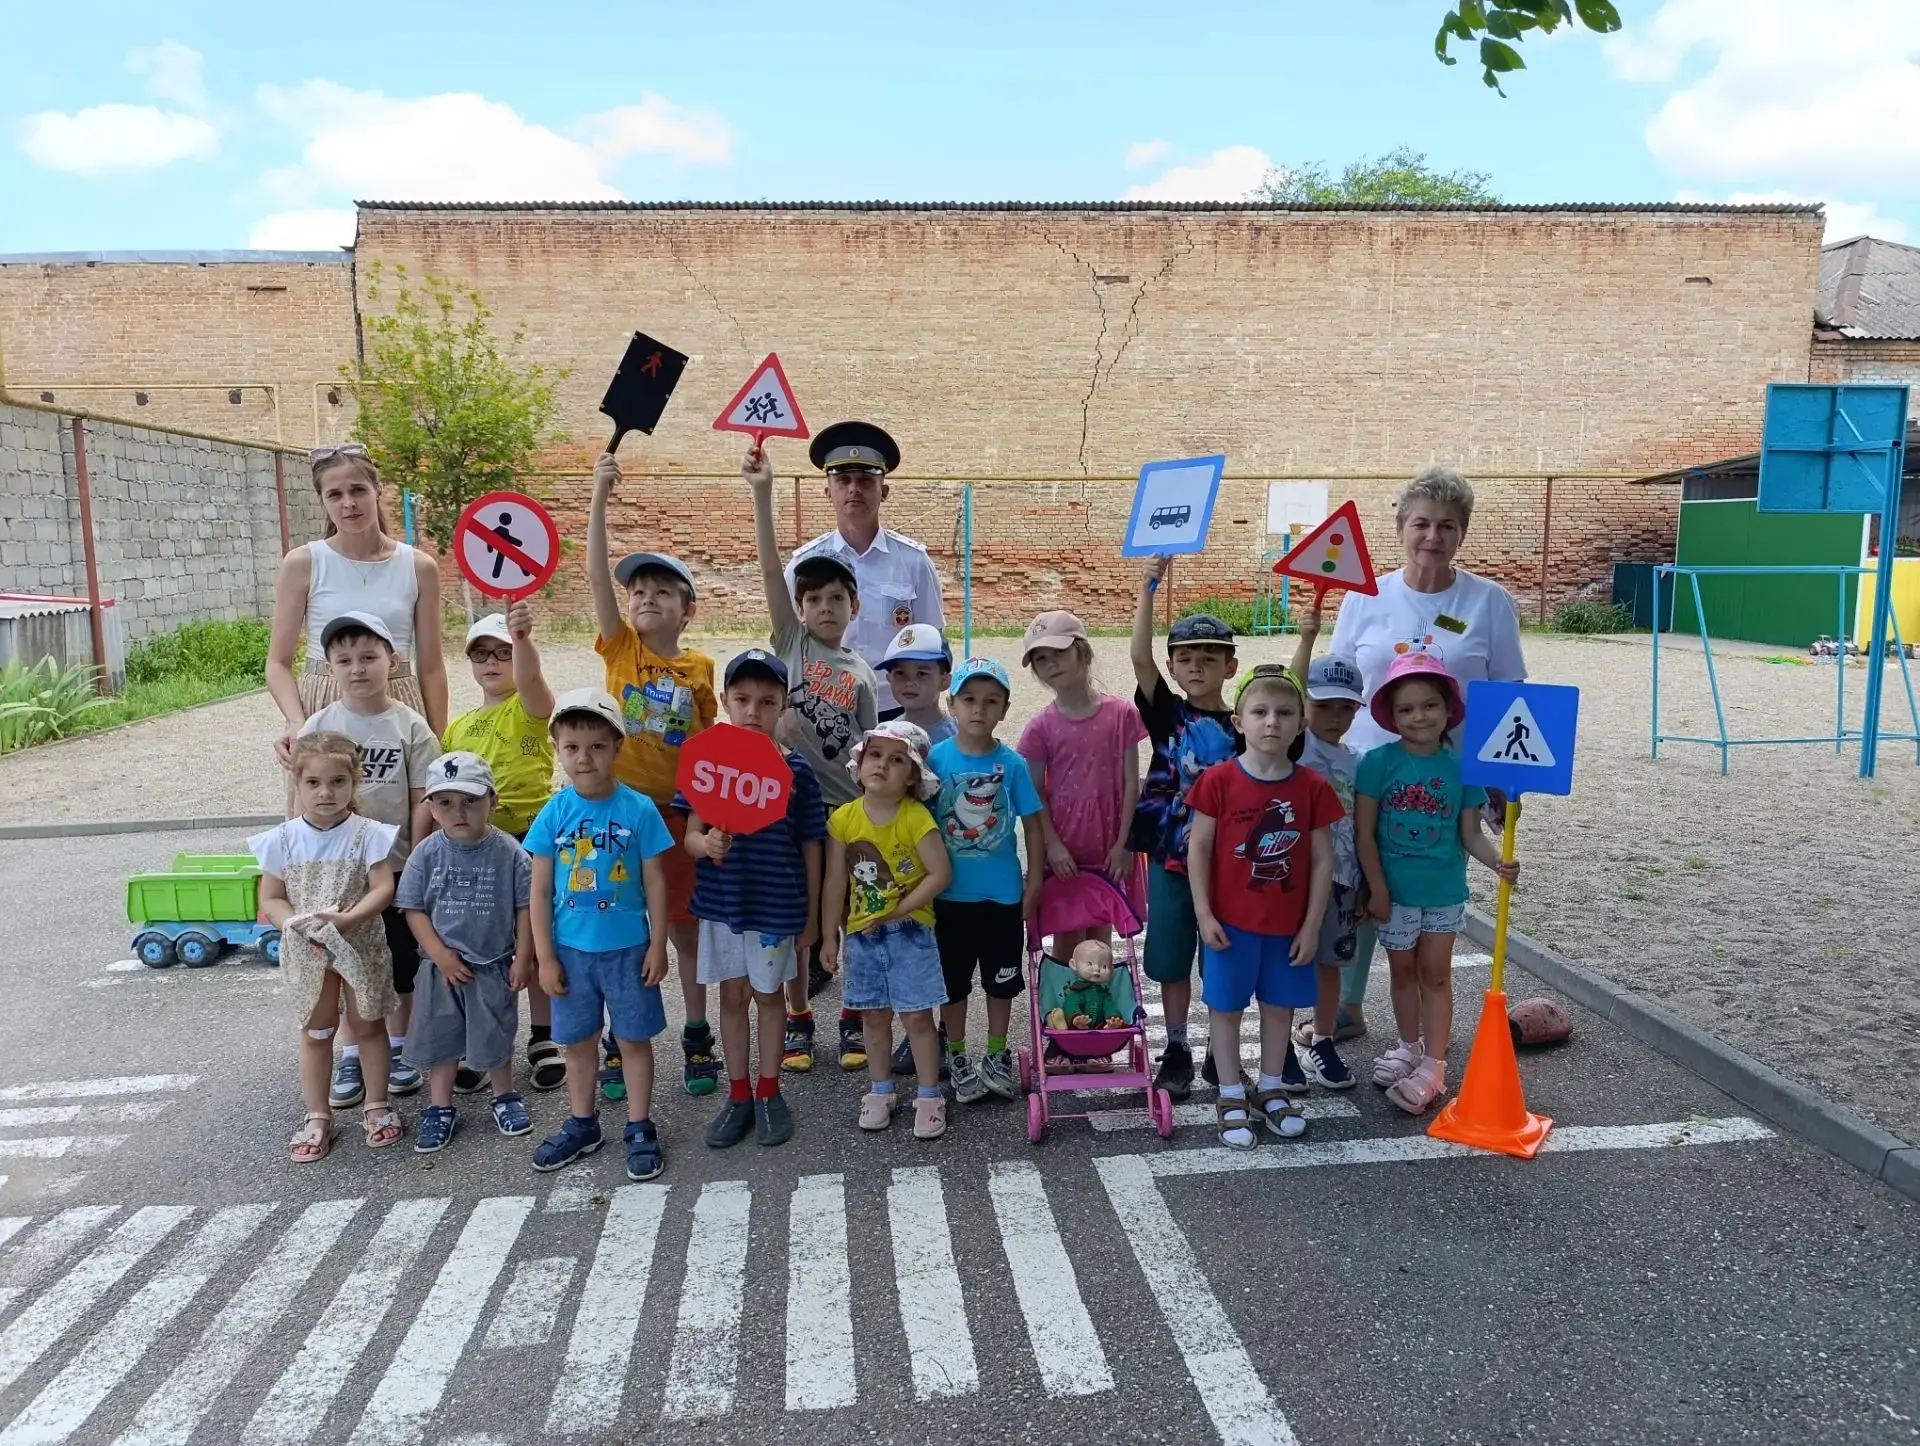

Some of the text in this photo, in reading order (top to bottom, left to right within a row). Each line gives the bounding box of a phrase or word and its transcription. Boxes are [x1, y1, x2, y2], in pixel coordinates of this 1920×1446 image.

[803, 660, 857, 690] EEP ON
[645, 687, 671, 702] Think
[691, 760, 781, 810] STOP
